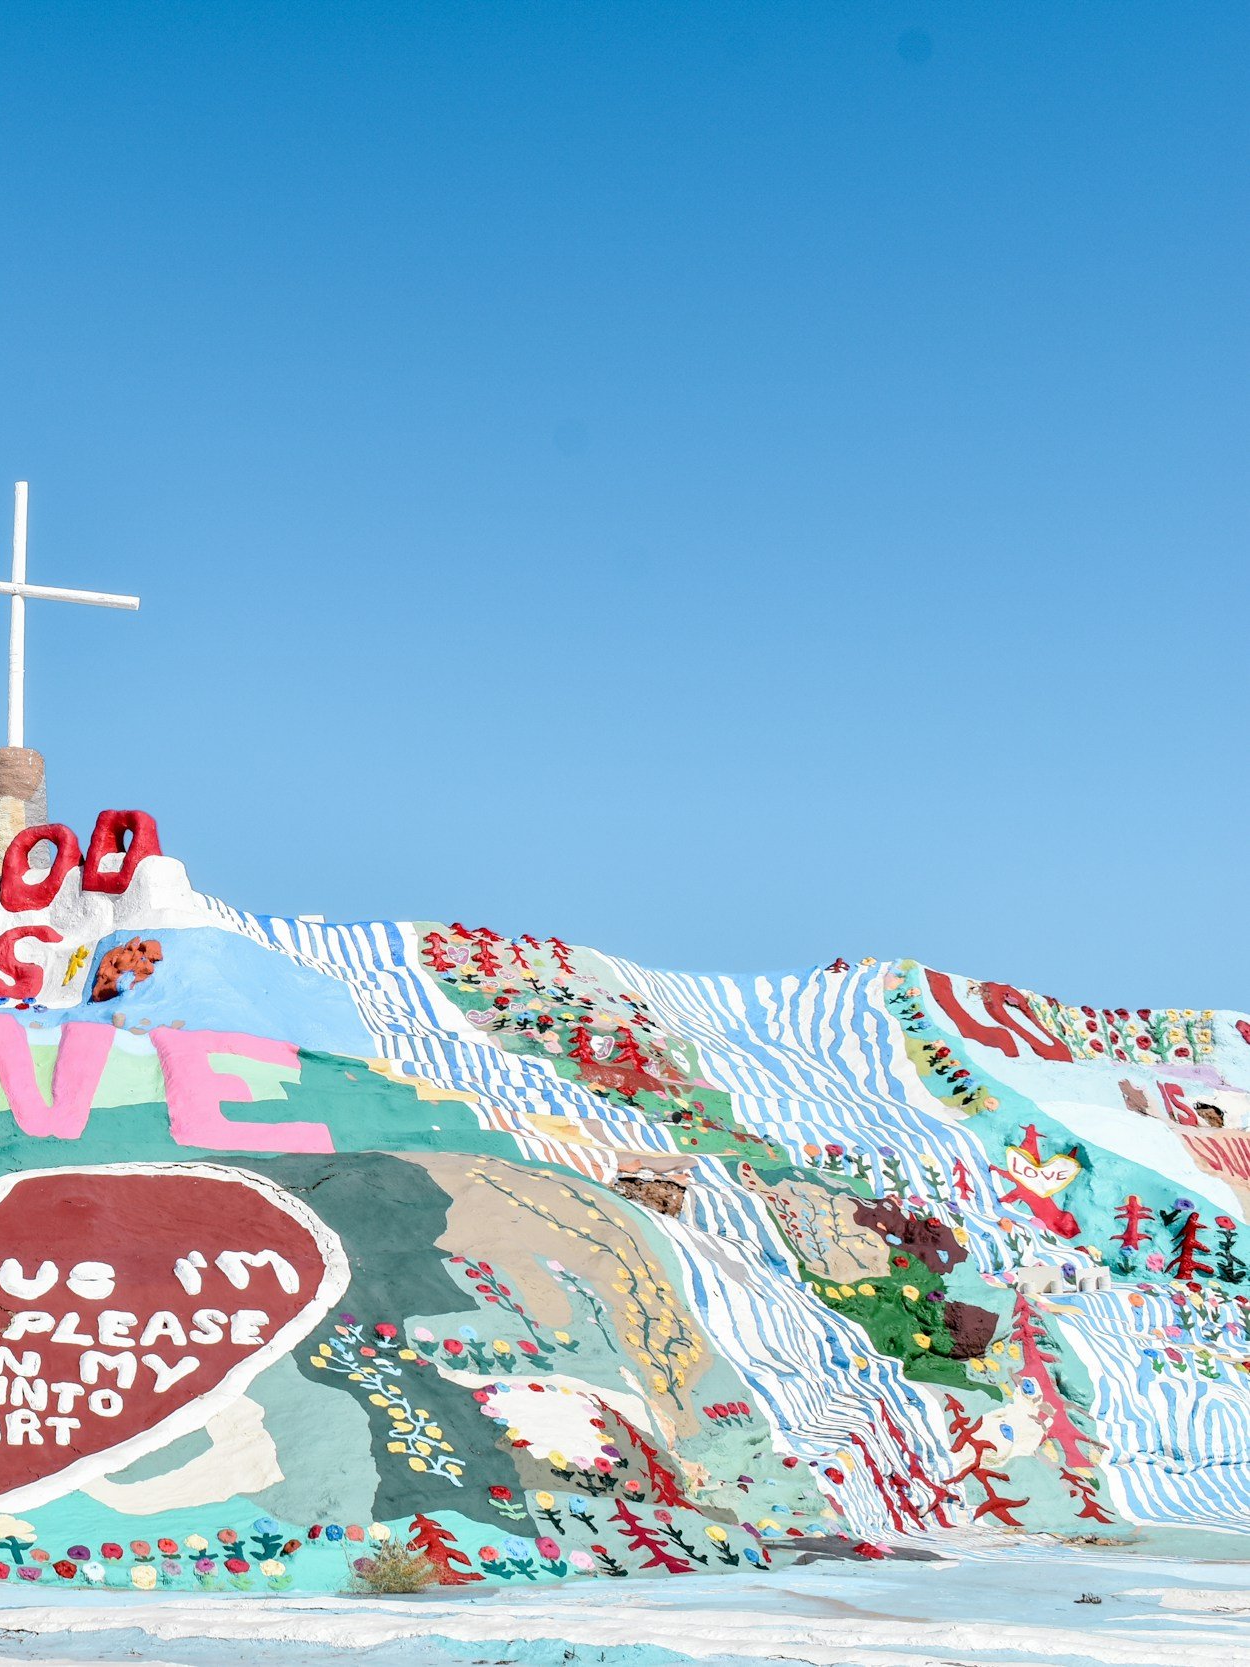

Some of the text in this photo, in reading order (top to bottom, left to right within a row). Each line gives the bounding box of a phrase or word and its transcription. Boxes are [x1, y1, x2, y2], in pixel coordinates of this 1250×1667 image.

[1012, 1156, 1067, 1181] LOVE
[173, 1248, 300, 1295] I'M
[1, 1308, 274, 1347] PLEASE
[78, 1348, 202, 1394] MY
